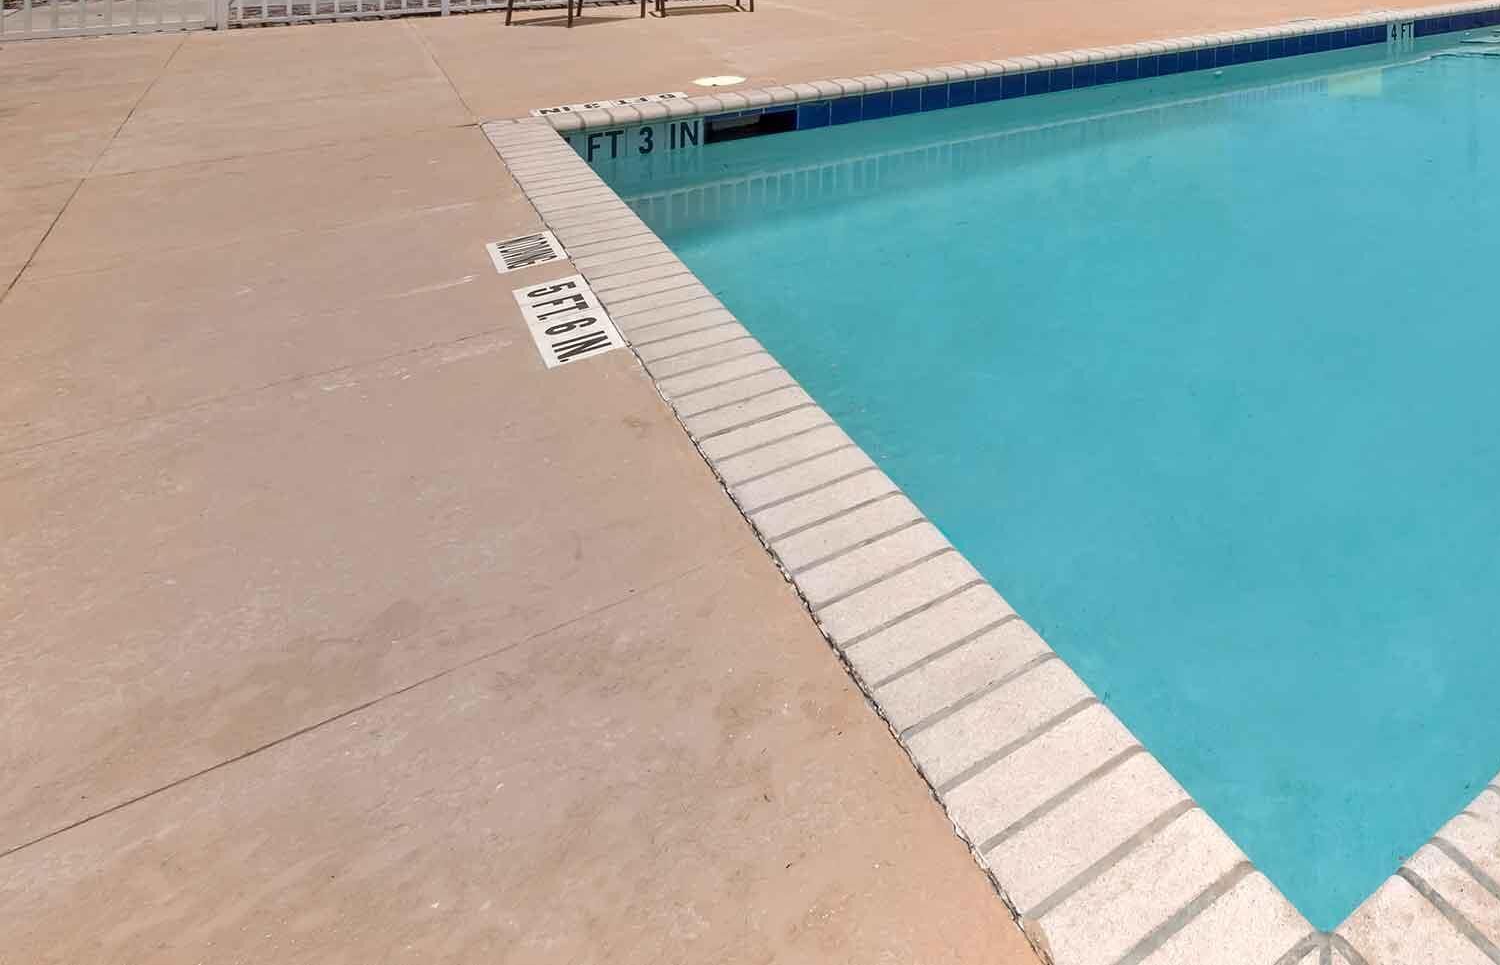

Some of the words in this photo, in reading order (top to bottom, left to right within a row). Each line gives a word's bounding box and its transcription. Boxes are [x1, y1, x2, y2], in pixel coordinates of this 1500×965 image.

[1391, 24, 1397, 40] 4
[1401, 22, 1413, 38] FT
[587, 130, 624, 162] FT
[639, 127, 654, 154] 3
[670, 121, 699, 148] IN
[527, 281, 577, 298] 5
[545, 317, 598, 335] 6
[551, 330, 612, 363] IN.
